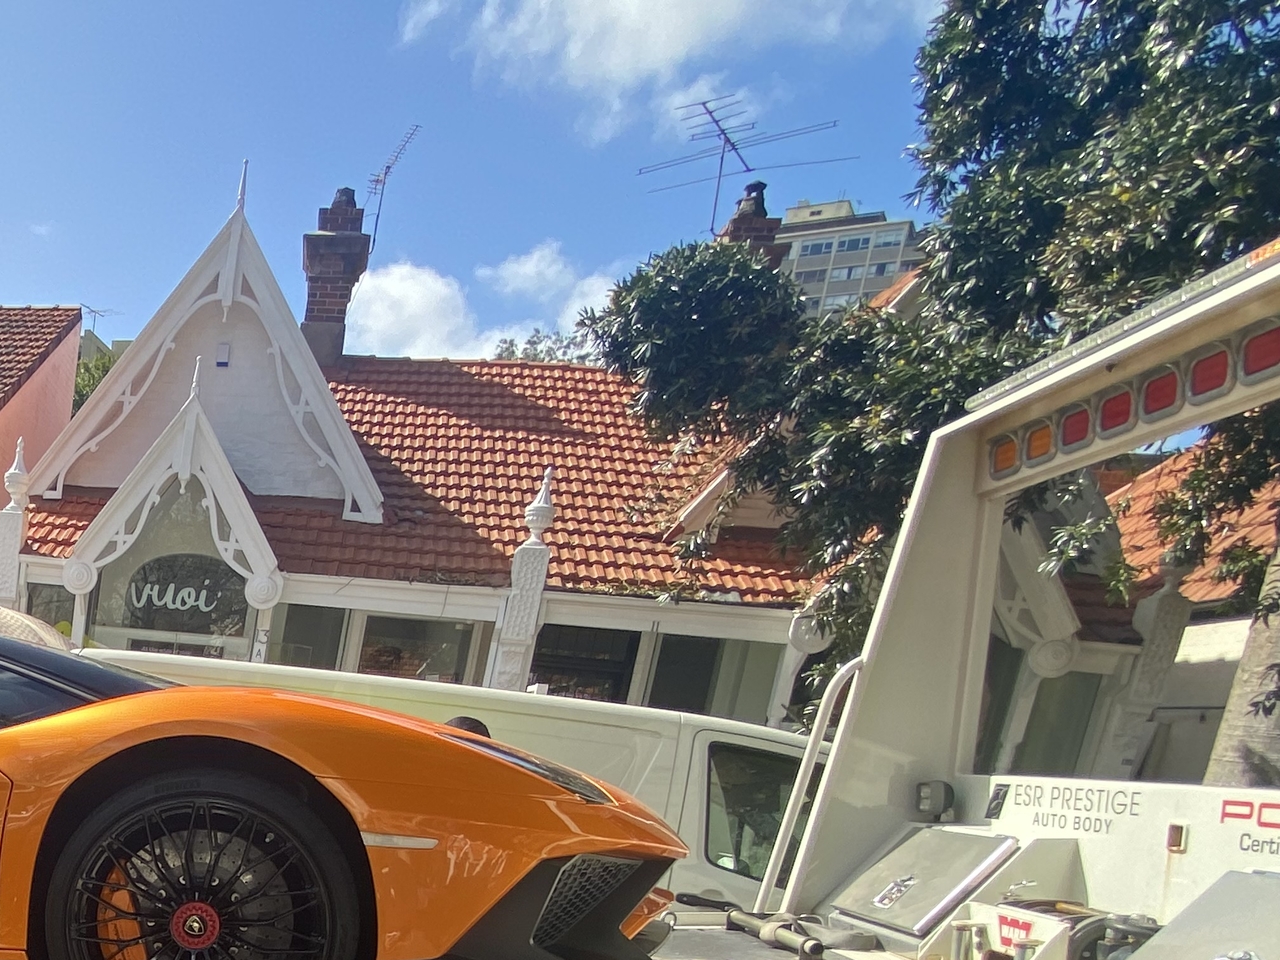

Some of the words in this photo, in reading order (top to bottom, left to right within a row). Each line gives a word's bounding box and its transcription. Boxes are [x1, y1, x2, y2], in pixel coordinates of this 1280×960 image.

[131, 578, 218, 613] vuoi
[1014, 784, 1043, 807] ESR
[1050, 786, 1142, 816] PRESTIGE
[1032, 812, 1067, 829] AUTO
[1073, 816, 1113, 834] BODY
